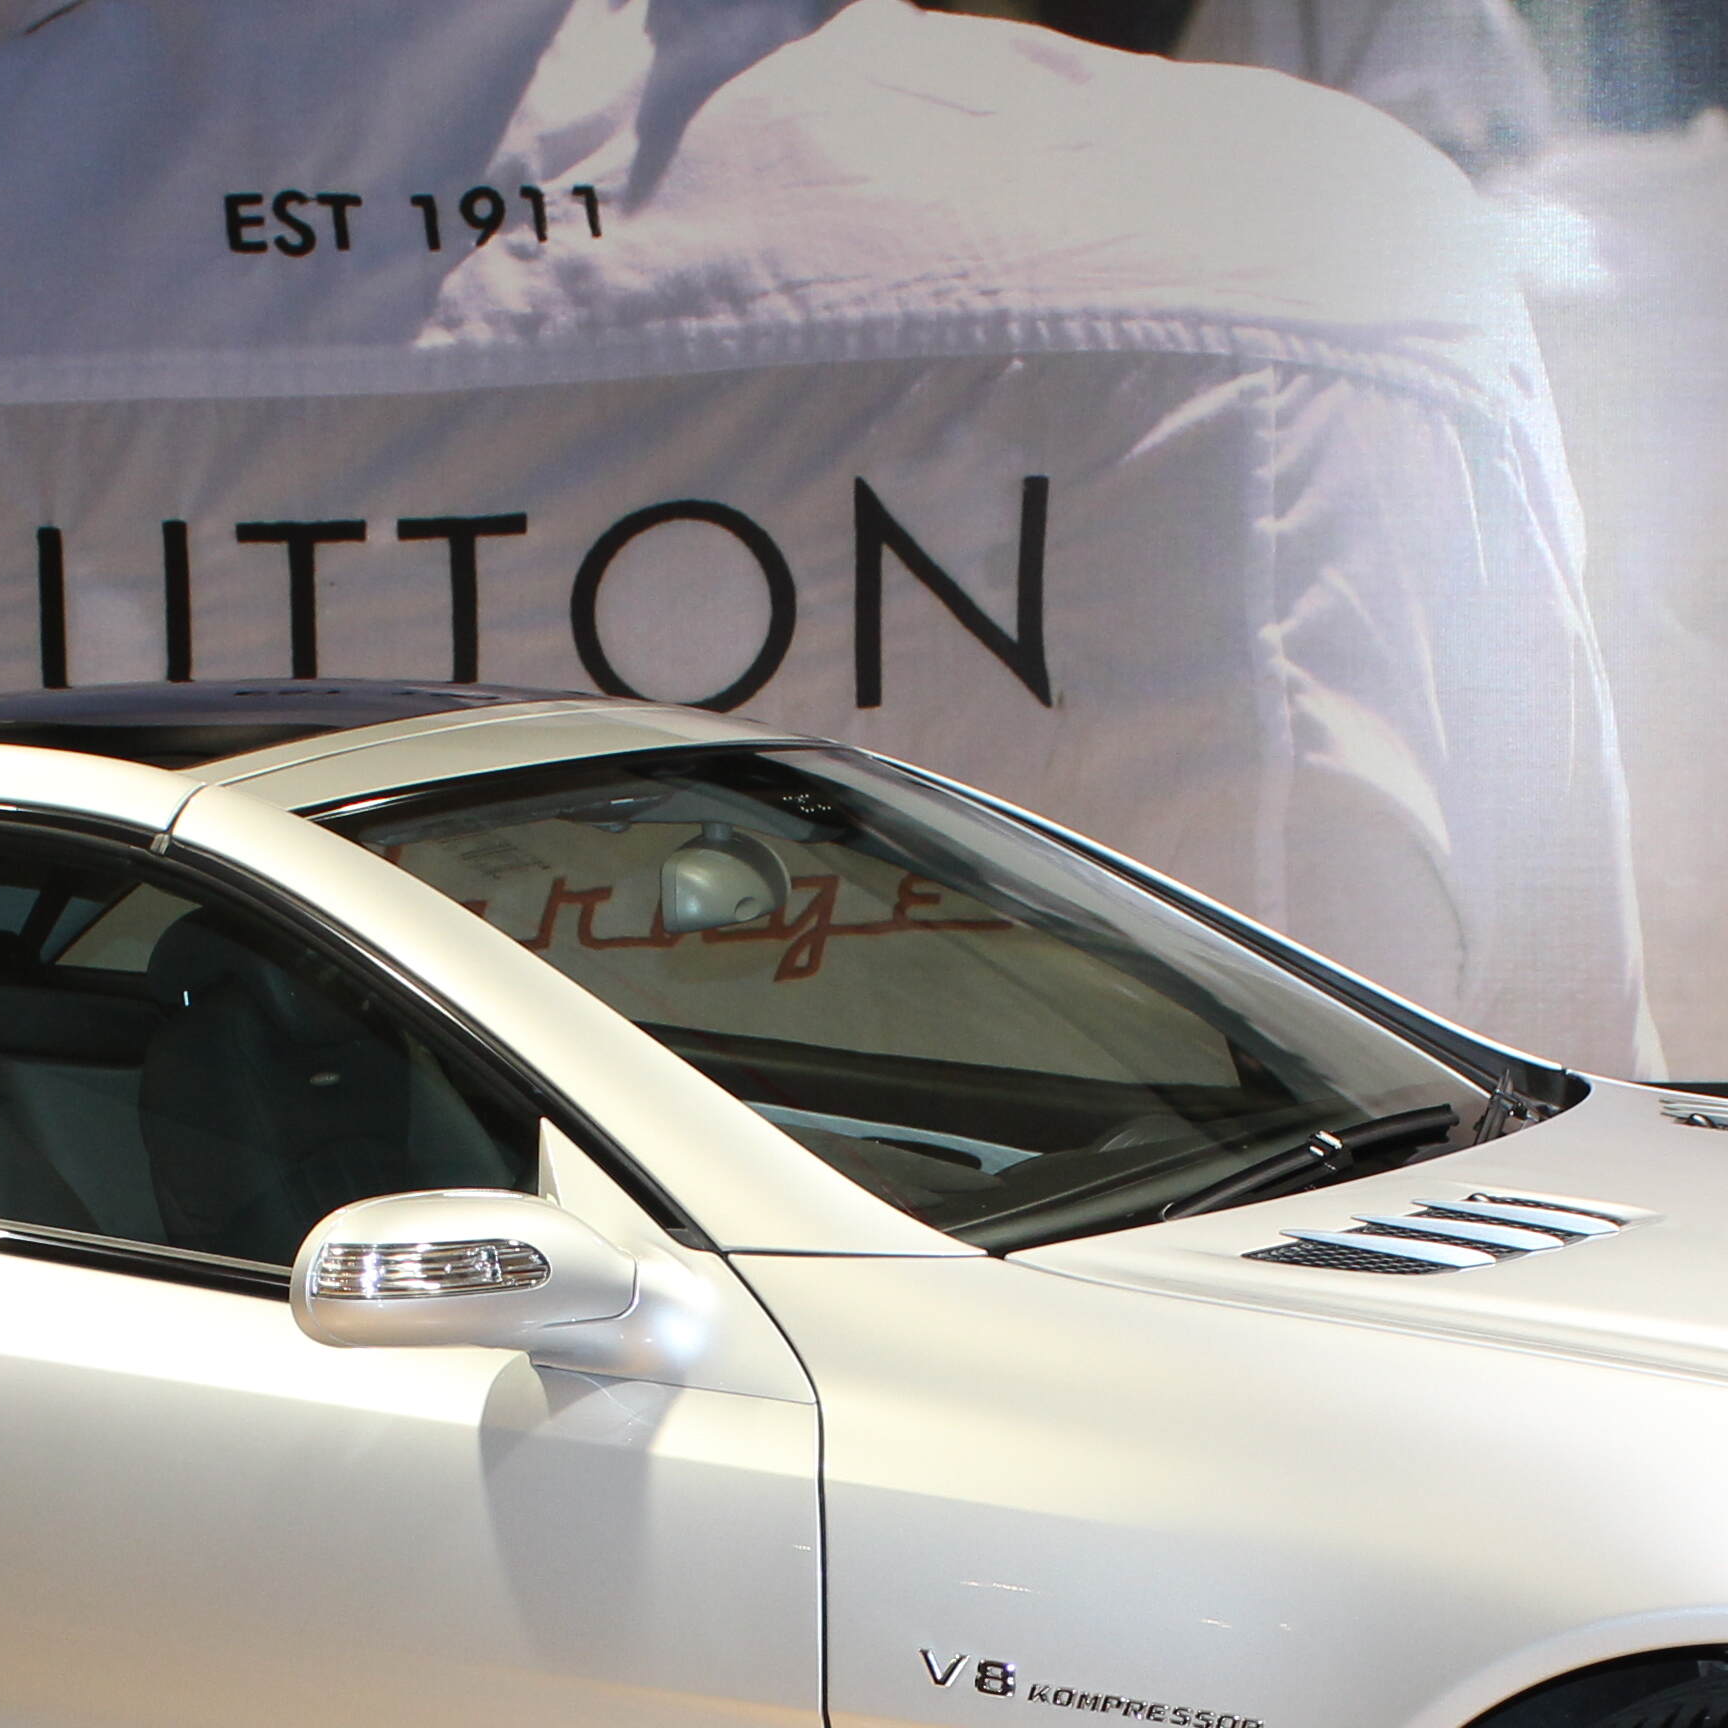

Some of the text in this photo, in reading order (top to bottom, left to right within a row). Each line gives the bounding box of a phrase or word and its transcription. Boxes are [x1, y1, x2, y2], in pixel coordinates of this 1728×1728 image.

[224, 184, 603, 258] EST 1911
[918, 1647, 1017, 1697] V8
